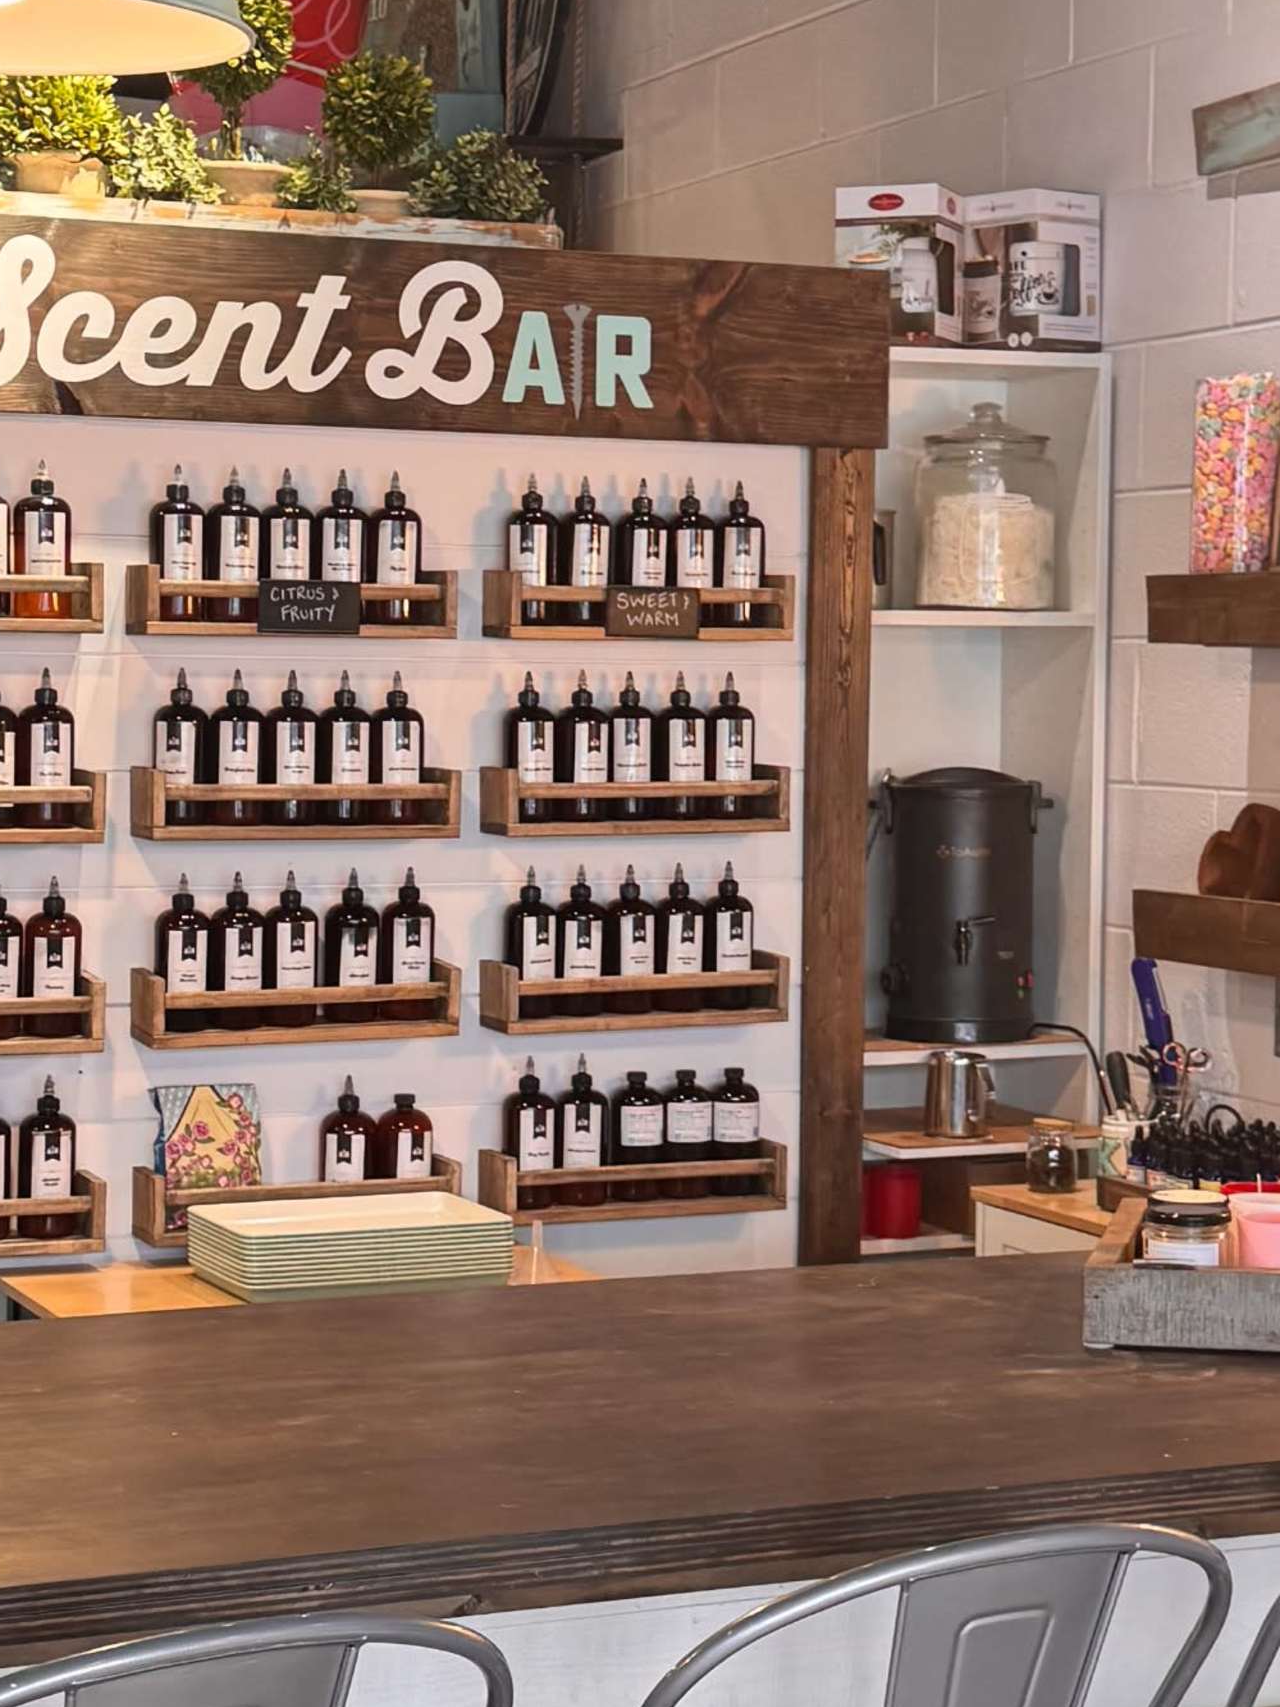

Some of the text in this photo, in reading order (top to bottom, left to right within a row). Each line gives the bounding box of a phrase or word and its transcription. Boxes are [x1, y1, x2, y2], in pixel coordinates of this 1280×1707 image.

[270, 585, 326, 602] CITRUS
[616, 591, 677, 610] SWEET
[281, 604, 336, 623] FRUITY
[626, 610, 679, 626] WARM
